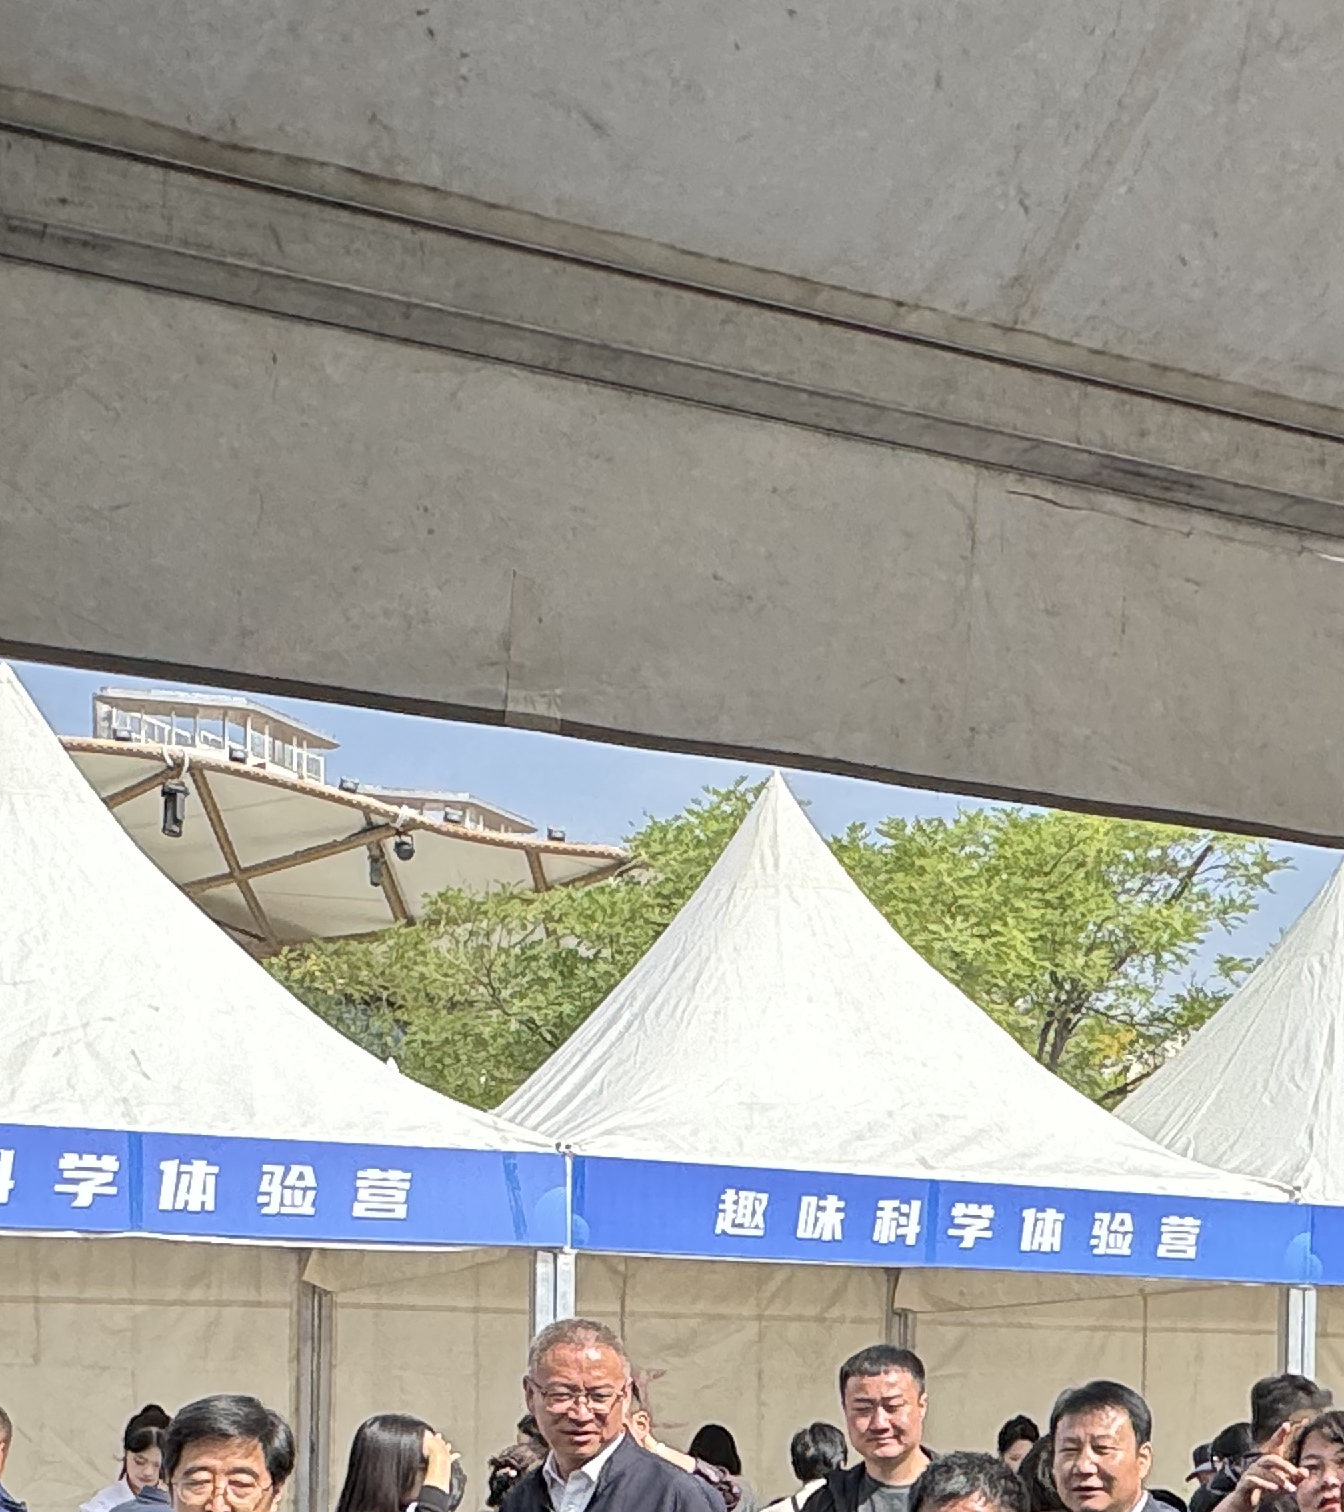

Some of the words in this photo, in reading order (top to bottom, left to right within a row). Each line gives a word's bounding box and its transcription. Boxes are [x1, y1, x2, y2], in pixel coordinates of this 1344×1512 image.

[715, 1189, 1202, 1260] 趣味科学体验营
